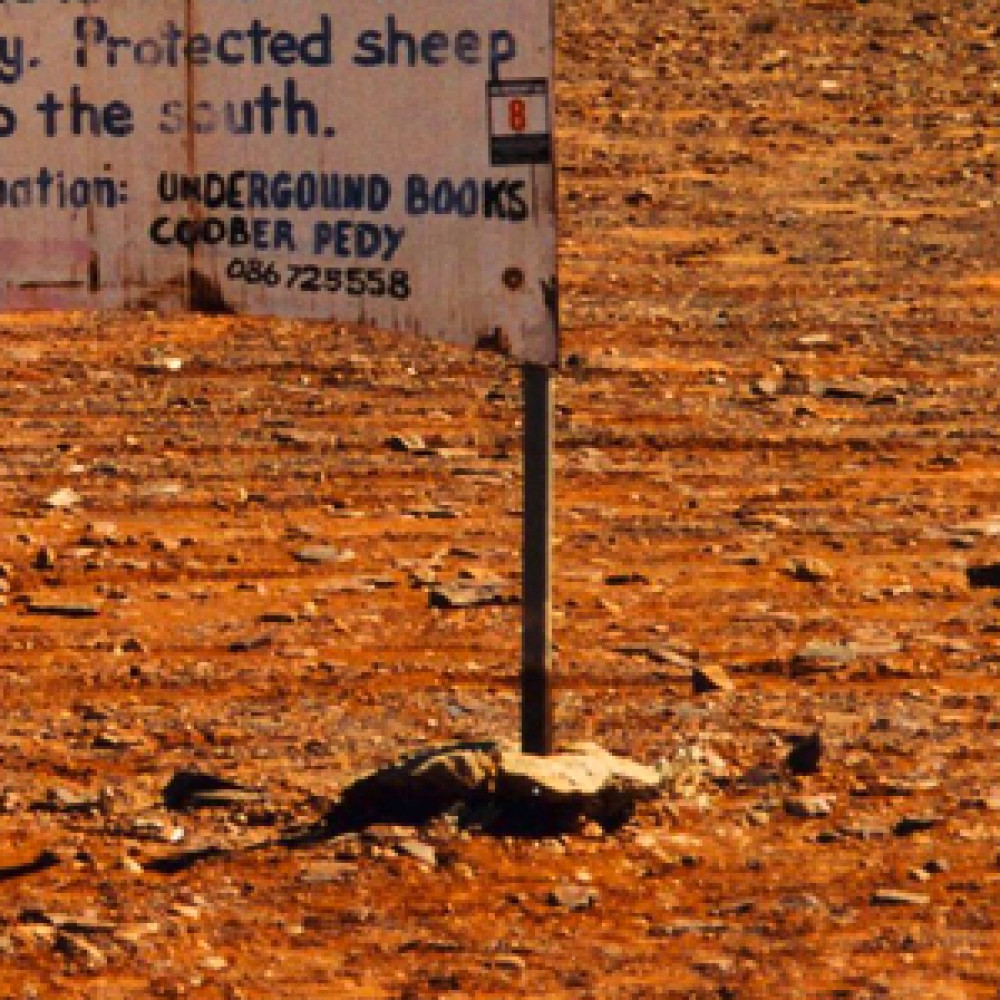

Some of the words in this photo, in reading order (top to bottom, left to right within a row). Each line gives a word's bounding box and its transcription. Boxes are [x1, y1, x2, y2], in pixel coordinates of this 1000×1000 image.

[74, 13, 332, 68] Protected
[352, 13, 518, 84] sheep
[36, 84, 134, 137] the
[405, 174, 529, 222] BOOKS
[149, 216, 296, 253] COOBER
[313, 219, 406, 262] PEDY
